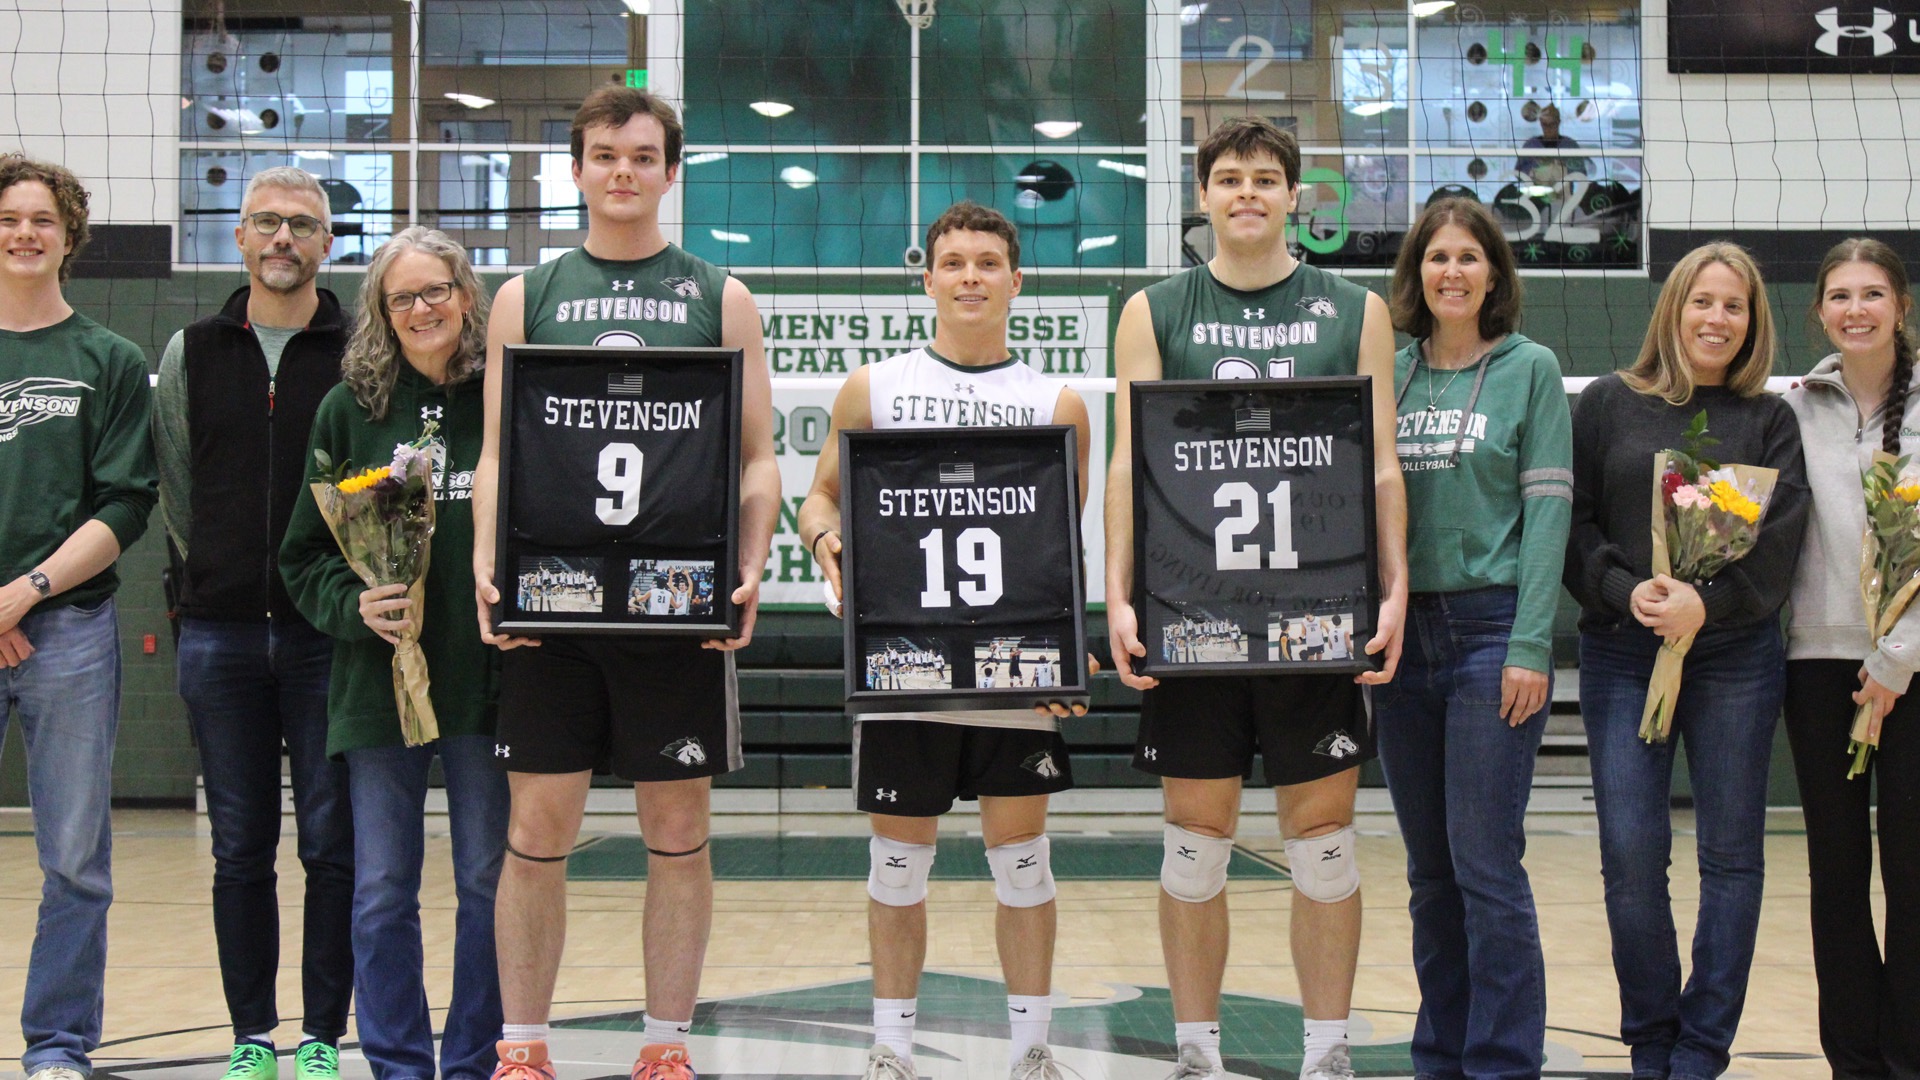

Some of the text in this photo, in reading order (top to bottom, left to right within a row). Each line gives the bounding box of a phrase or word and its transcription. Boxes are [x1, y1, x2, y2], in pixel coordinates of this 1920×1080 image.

[1227, 35, 1285, 100] 2
[1487, 30, 1583, 97] 44
[556, 297, 688, 324] STEVENSON
[881, 315, 1078, 340] LASSE
[1193, 321, 1317, 350] STEVENSON
[765, 348, 848, 372] CAA
[544, 396, 702, 431] STEVENSON
[892, 395, 1035, 426] STEVENSON
[1174, 435, 1334, 472] STEVENSON
[1400, 459, 1456, 471] OLLEYBALL
[595, 442, 643, 525] 9
[879, 486, 1037, 517] STEVENSON
[1213, 480, 1298, 571] 21
[919, 527, 1004, 608] 19
